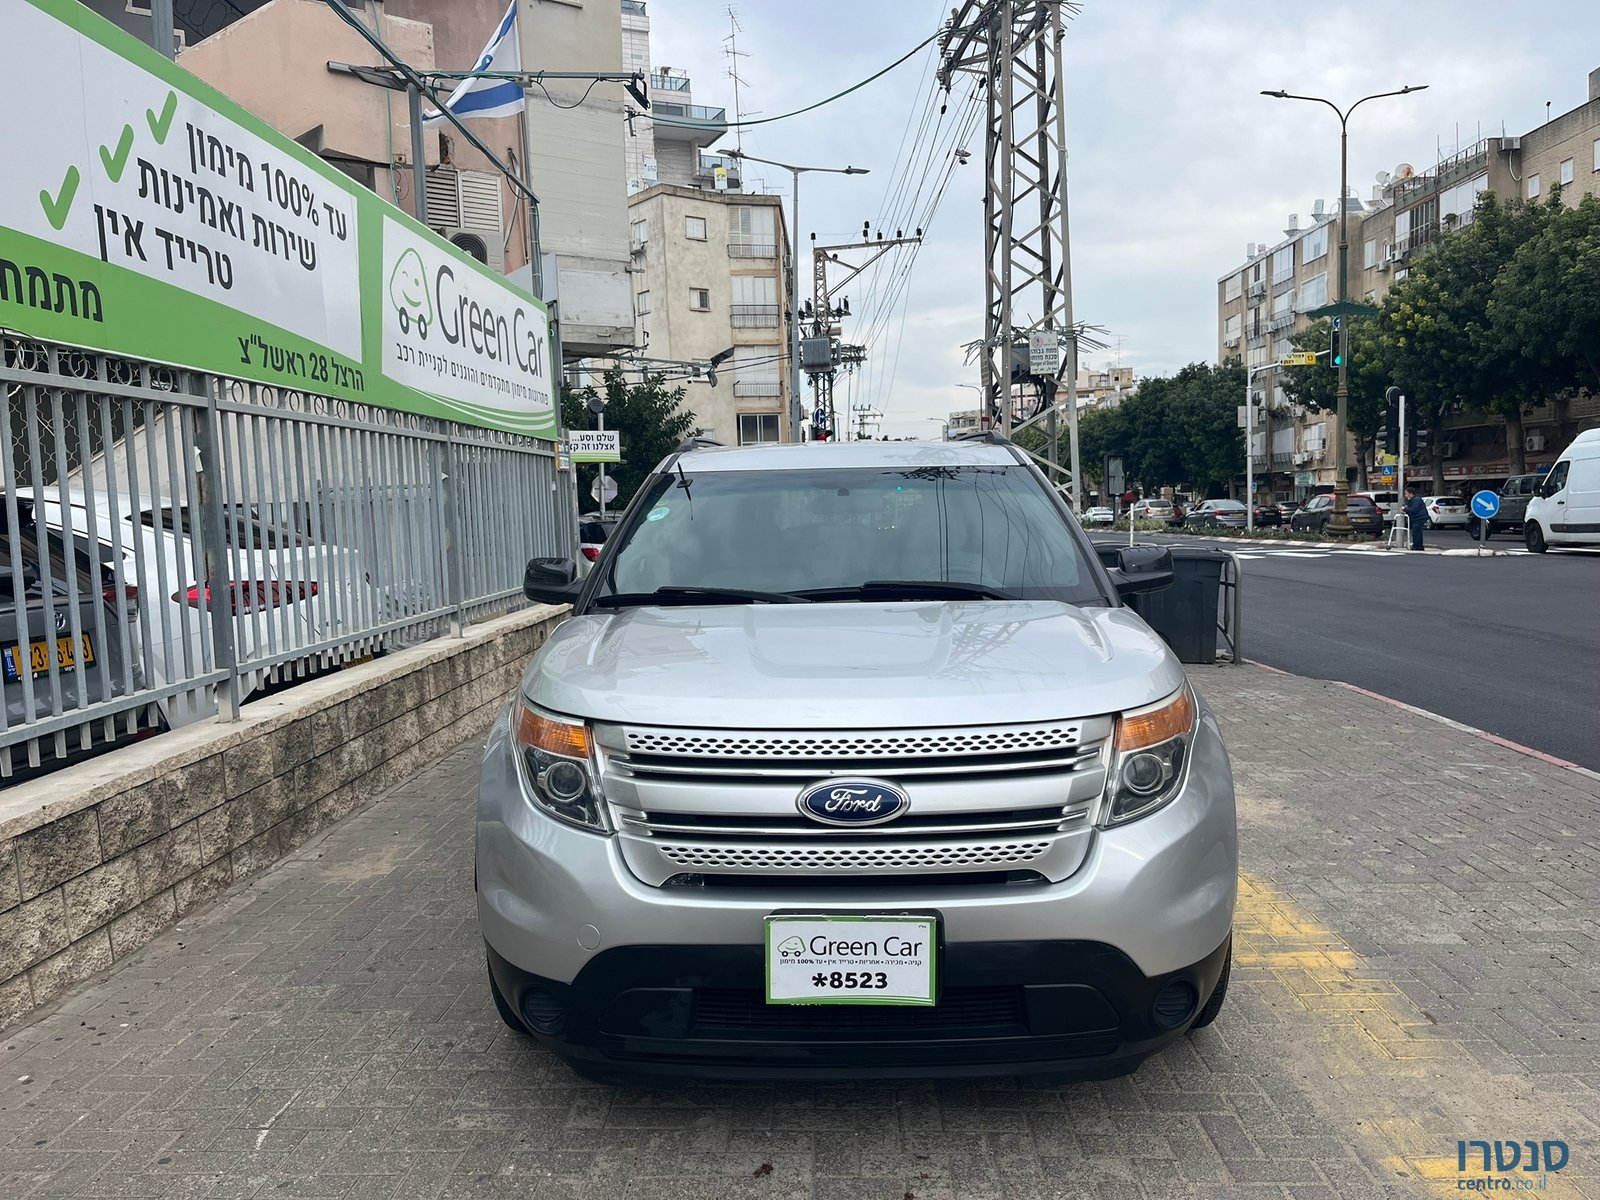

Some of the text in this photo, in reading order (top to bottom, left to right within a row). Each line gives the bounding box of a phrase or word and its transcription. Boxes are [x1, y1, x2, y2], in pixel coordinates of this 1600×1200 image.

[186, 122, 347, 241] עד 100% מימון
[137, 157, 316, 271] שירות ואמינות
[94, 203, 233, 290] טרייד אין
[436, 264, 543, 378] Green Car
[396, 342, 415, 364] רכב
[418, 350, 448, 377] לקניית
[309, 352, 328, 382] 28
[331, 356, 364, 391] הרצל
[451, 361, 479, 384] והוגנים
[480, 371, 510, 395] מתקדמים
[511, 382, 527, 399] מימון
[592, 442, 615, 451] אצלנו
[596, 433, 615, 442] שלם
[824, 788, 882, 812] Ford
[810, 936, 922, 957] Green Car
